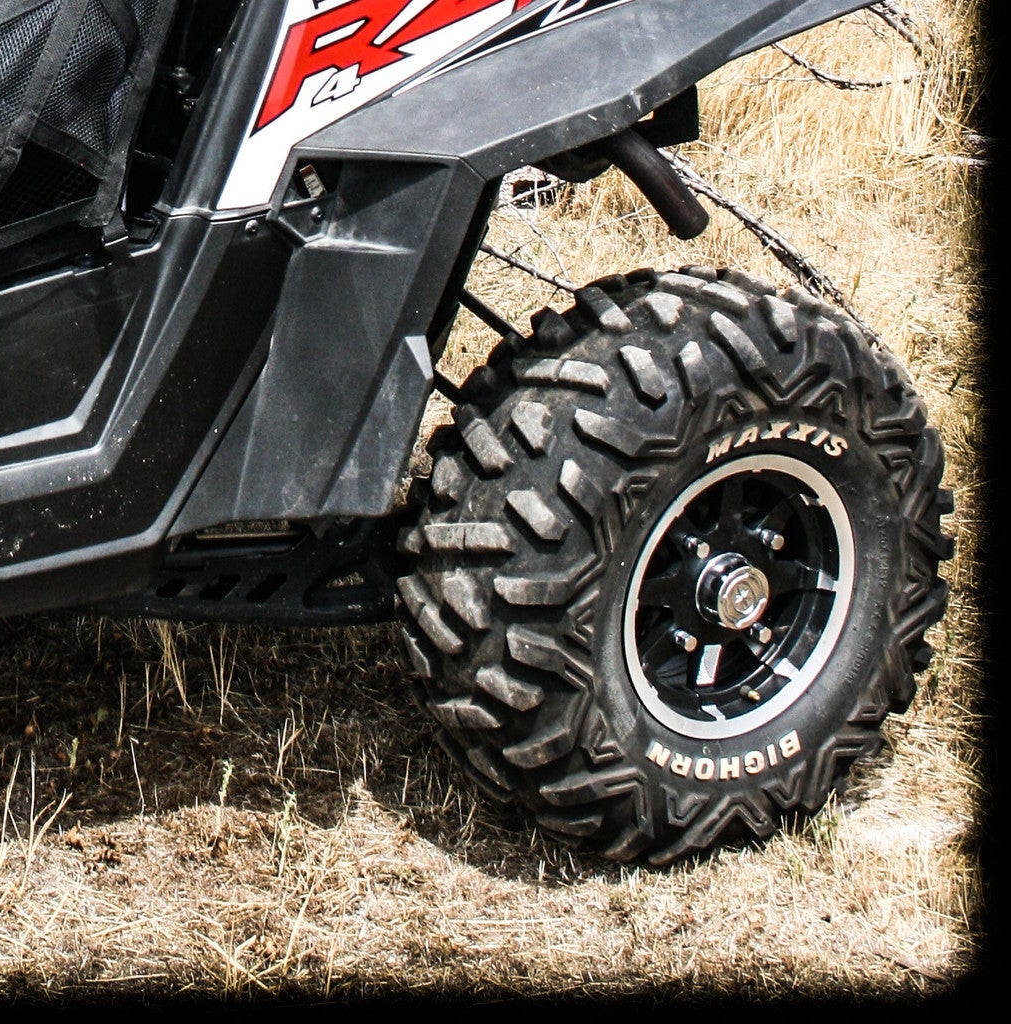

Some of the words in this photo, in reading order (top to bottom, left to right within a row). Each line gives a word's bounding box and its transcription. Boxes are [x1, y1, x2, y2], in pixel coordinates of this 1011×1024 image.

[310, 62, 362, 107] 4
[705, 421, 849, 464] MAXXIS
[646, 729, 801, 780] BIGHORN
